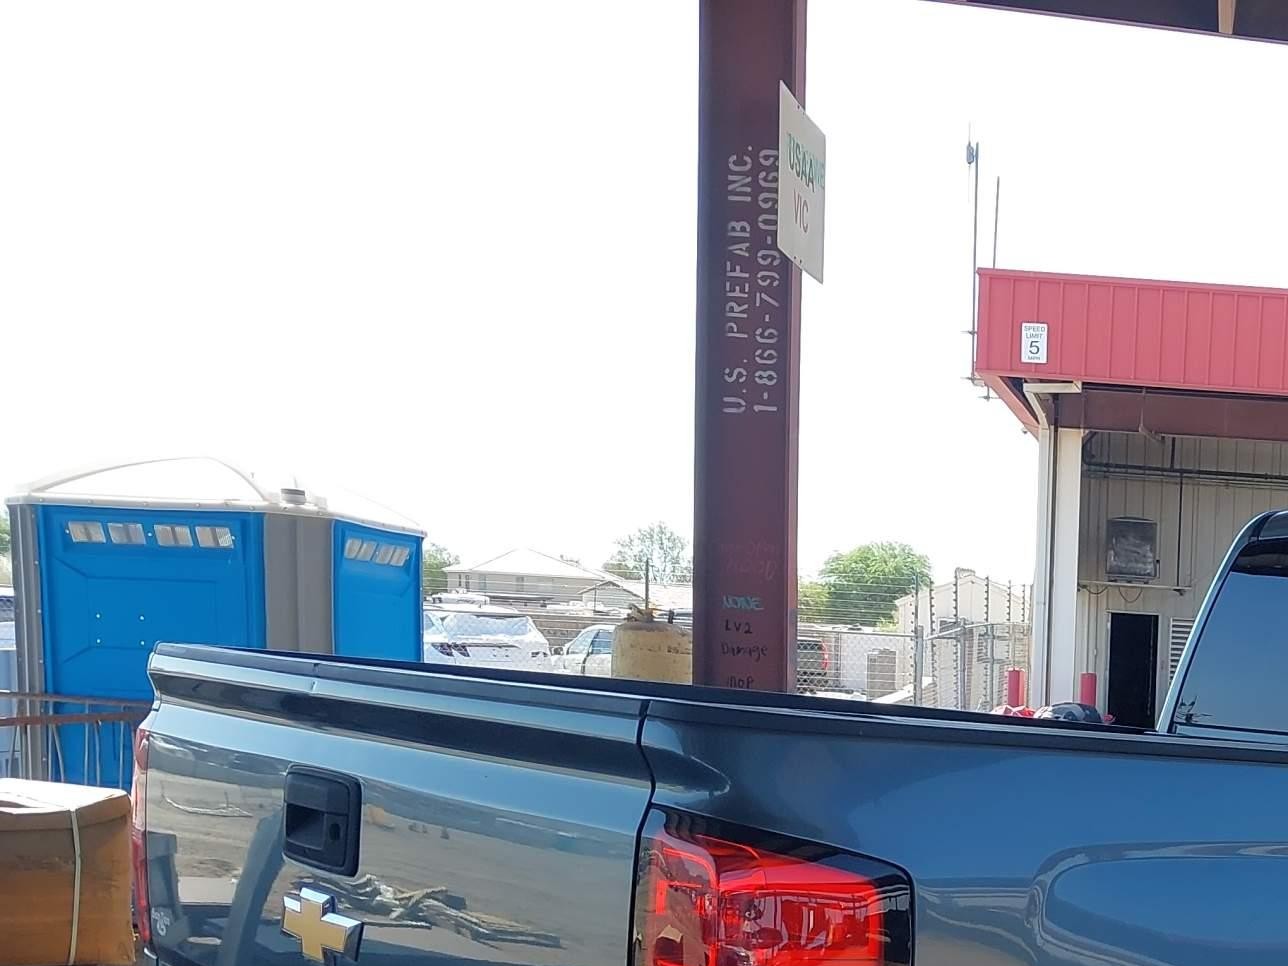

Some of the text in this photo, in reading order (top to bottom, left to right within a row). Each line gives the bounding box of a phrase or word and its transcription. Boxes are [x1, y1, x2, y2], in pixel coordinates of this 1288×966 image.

[787, 134, 815, 193] USAA
[793, 188, 809, 233] VIC
[722, 145, 754, 414] U.S. PREFAB INC.
[753, 148, 780, 413] 1-866-799-0969
[1028, 340, 1040, 355] 5
